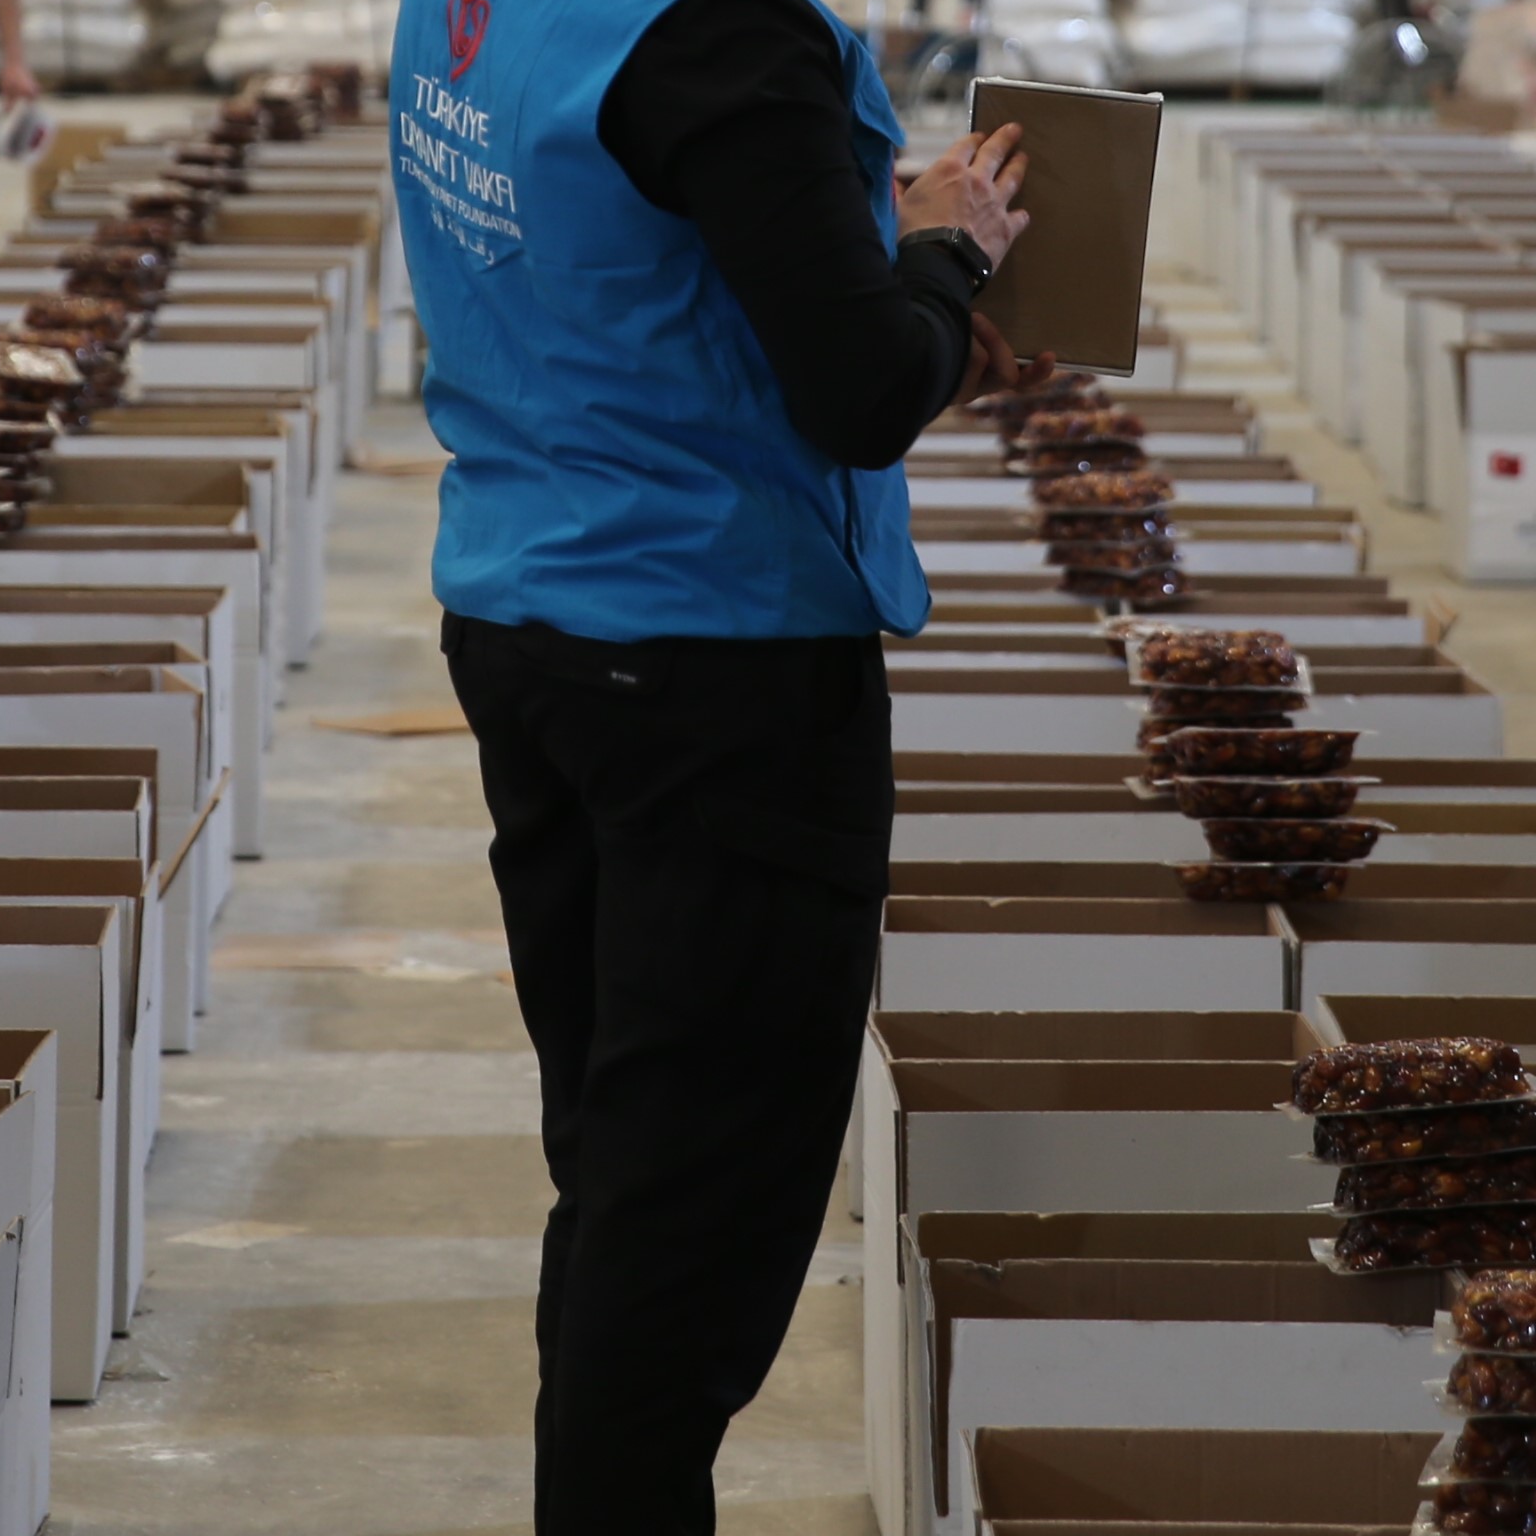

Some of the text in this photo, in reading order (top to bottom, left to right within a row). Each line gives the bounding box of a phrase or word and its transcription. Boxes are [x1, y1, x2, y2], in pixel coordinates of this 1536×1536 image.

[413, 73, 489, 148] TÜRKİYE
[400, 112, 516, 213] DİYANET VAKFI
[457, 198, 523, 241] FOUNDATION
